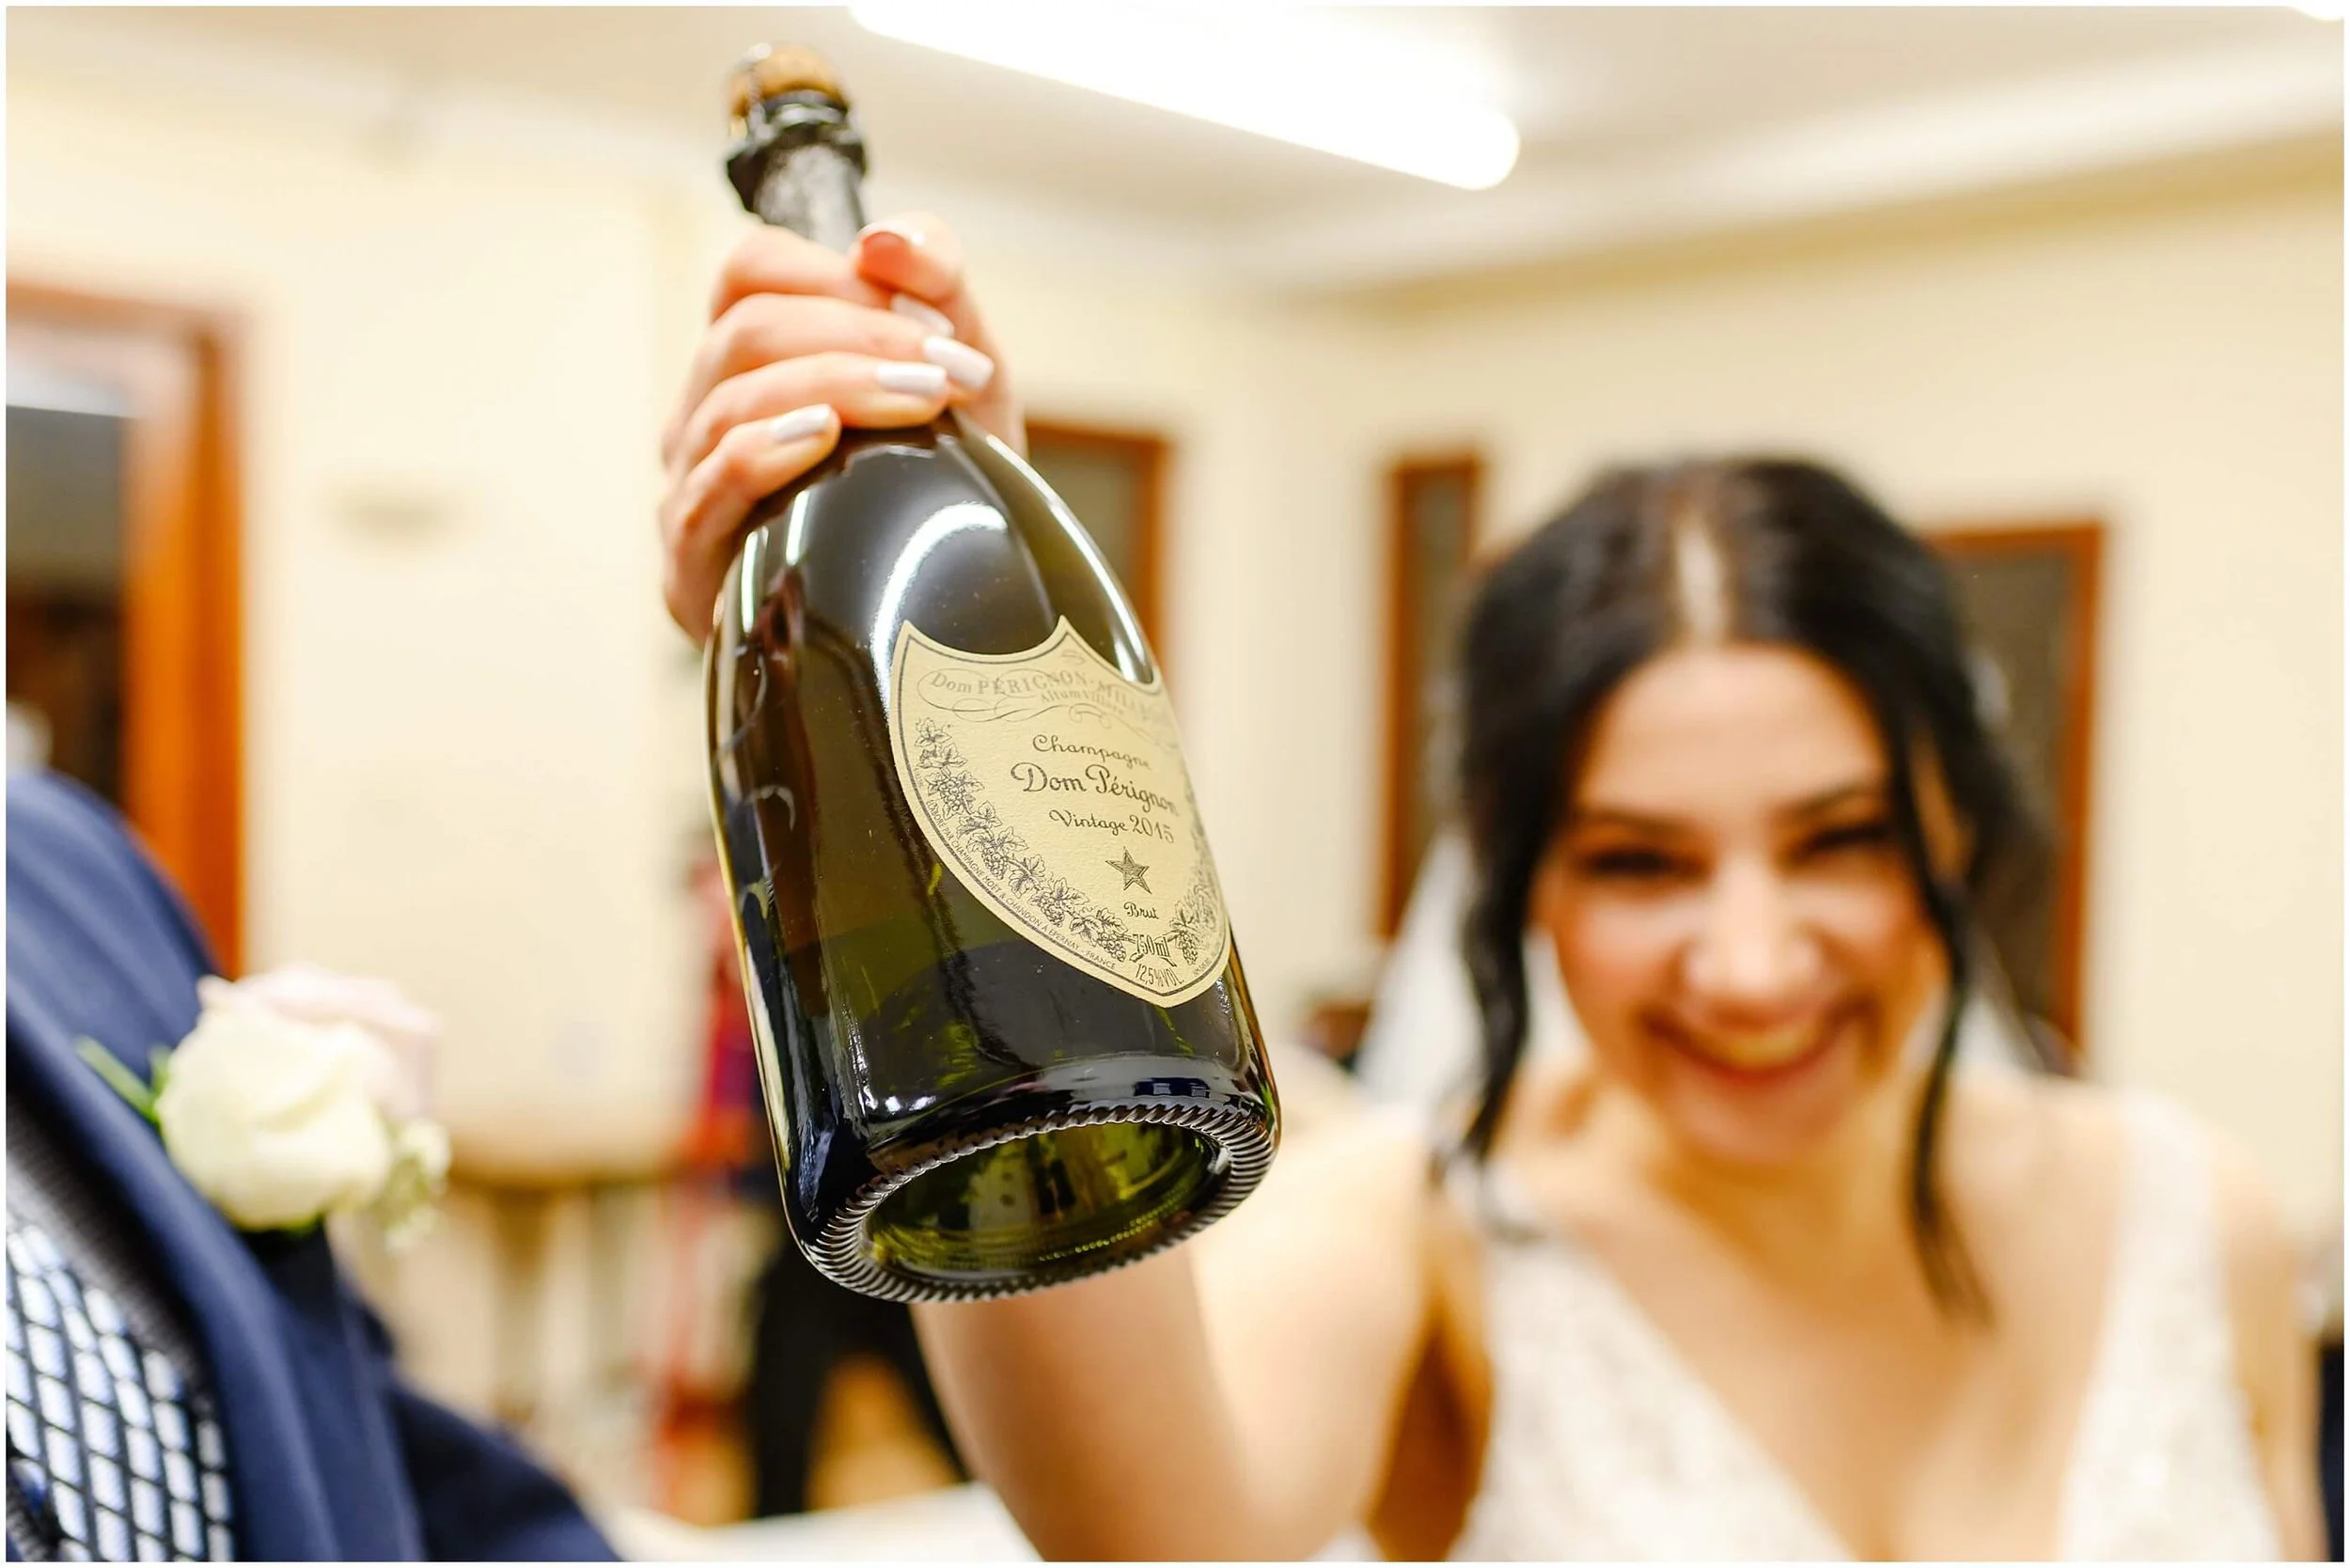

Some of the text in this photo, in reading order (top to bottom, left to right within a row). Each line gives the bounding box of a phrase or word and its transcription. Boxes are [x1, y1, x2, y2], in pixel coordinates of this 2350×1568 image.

[931, 672, 972, 694] Dom
[1032, 734, 1152, 769] Champagne
[1010, 761, 1179, 817] Dom Pérignon
[1049, 809, 1174, 844] Vintage 2015
[950, 839, 984, 877] CHAMPAGNE
[1006, 897, 1042, 928] CHANDON
[1085, 950, 1117, 970] FRANCE
[1123, 902, 1160, 919] Brut
[1132, 933, 1171, 958] 750ml
